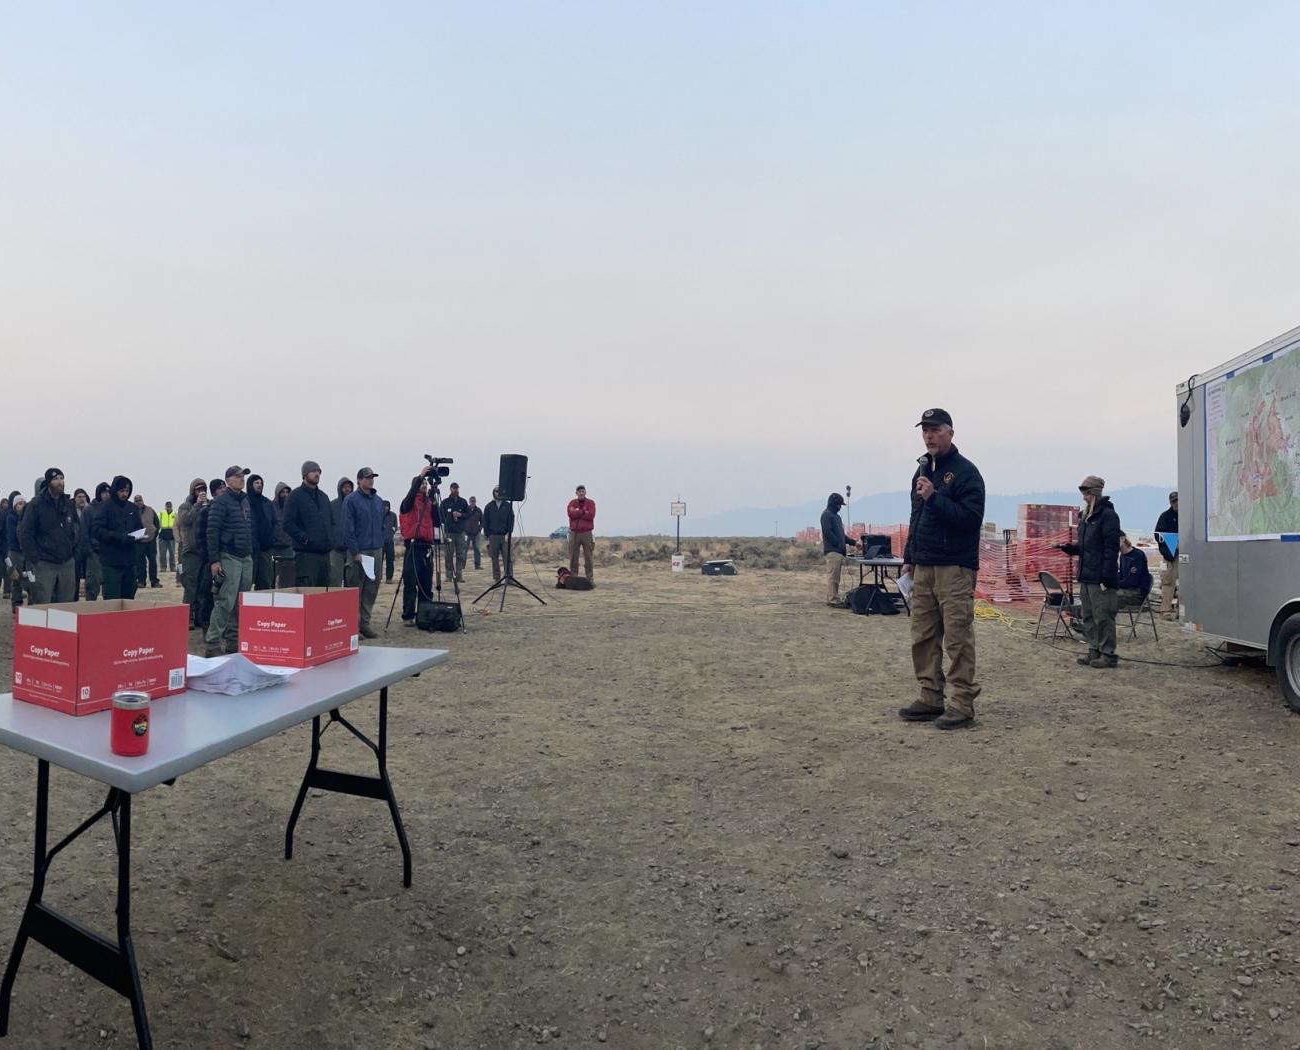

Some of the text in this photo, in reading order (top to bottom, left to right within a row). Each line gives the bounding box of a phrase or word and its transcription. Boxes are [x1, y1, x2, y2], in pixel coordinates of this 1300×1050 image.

[257, 620, 270, 628] Copy
[30, 645, 60, 658] Copy Paper
[123, 647, 154, 658] Copy Paper
[82, 688, 88, 696] 10
